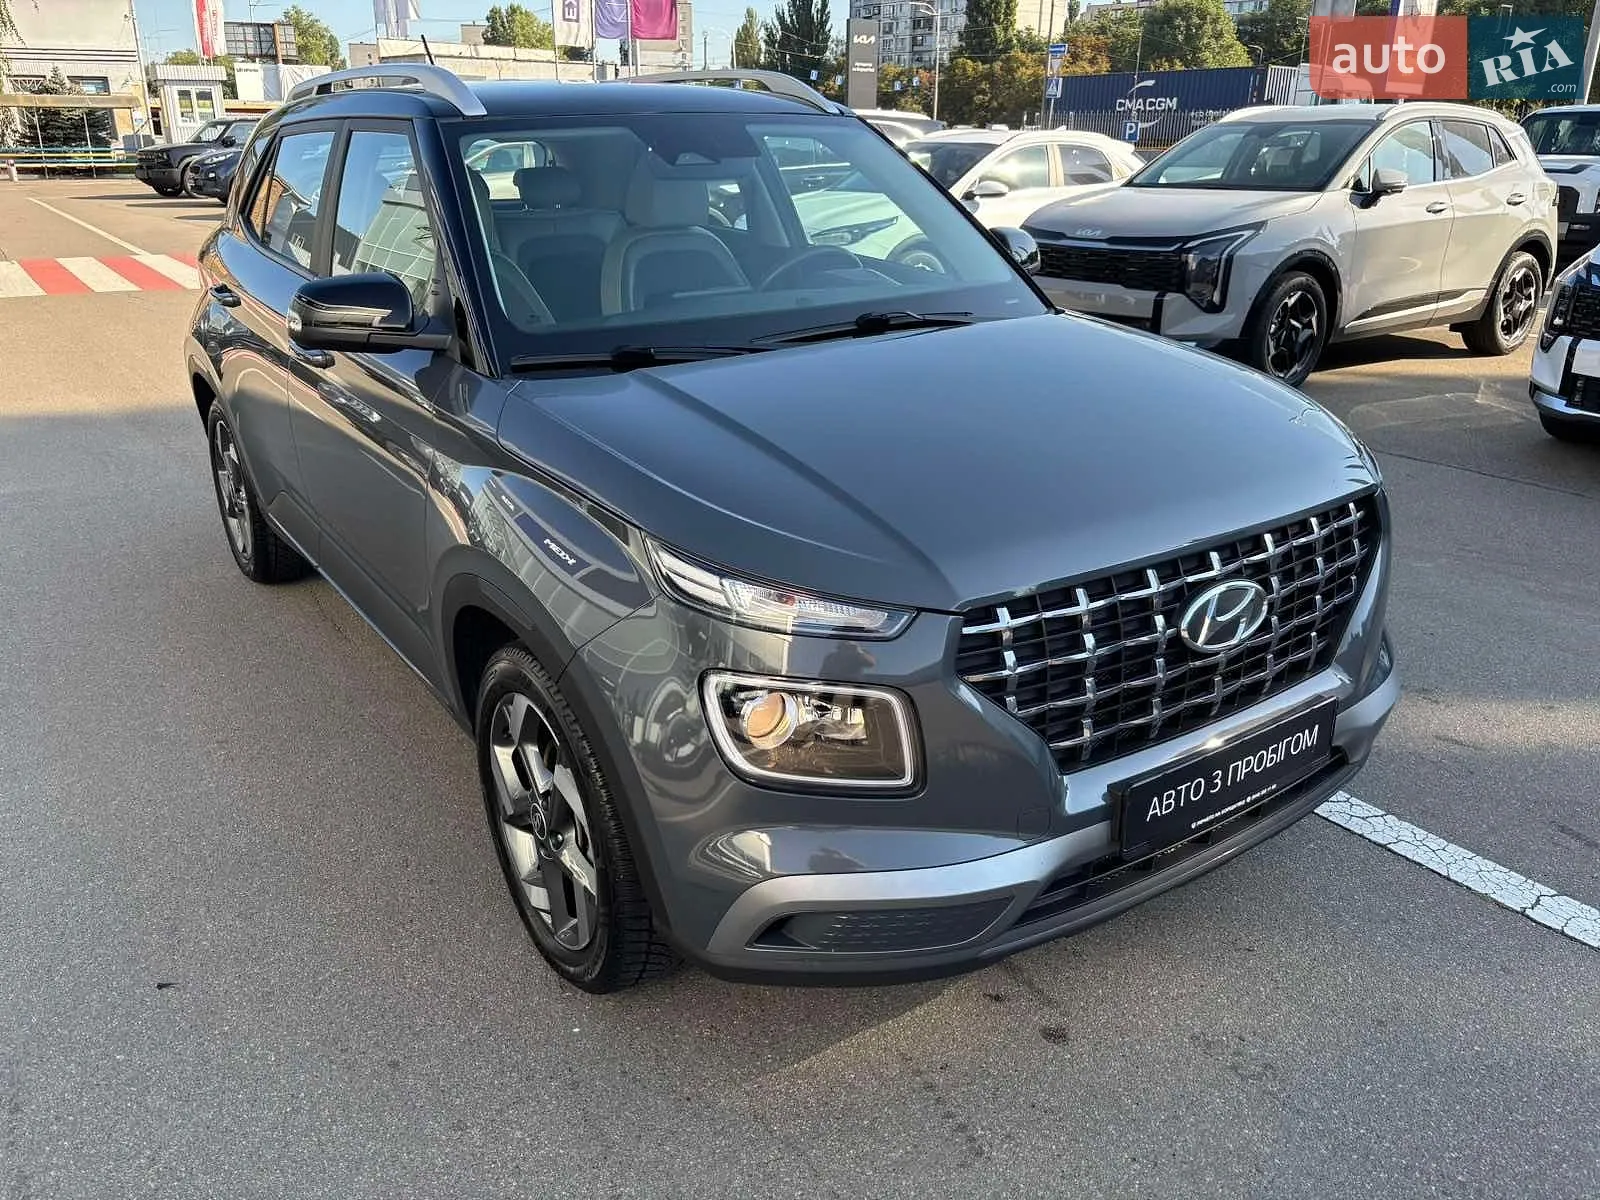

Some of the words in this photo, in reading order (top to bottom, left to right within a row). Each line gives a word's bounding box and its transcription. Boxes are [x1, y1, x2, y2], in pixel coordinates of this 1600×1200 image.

[1125, 122, 1136, 140] P
[1146, 776, 1205, 822] АВТО
[1227, 724, 1320, 787] ПРОБІГОМ
